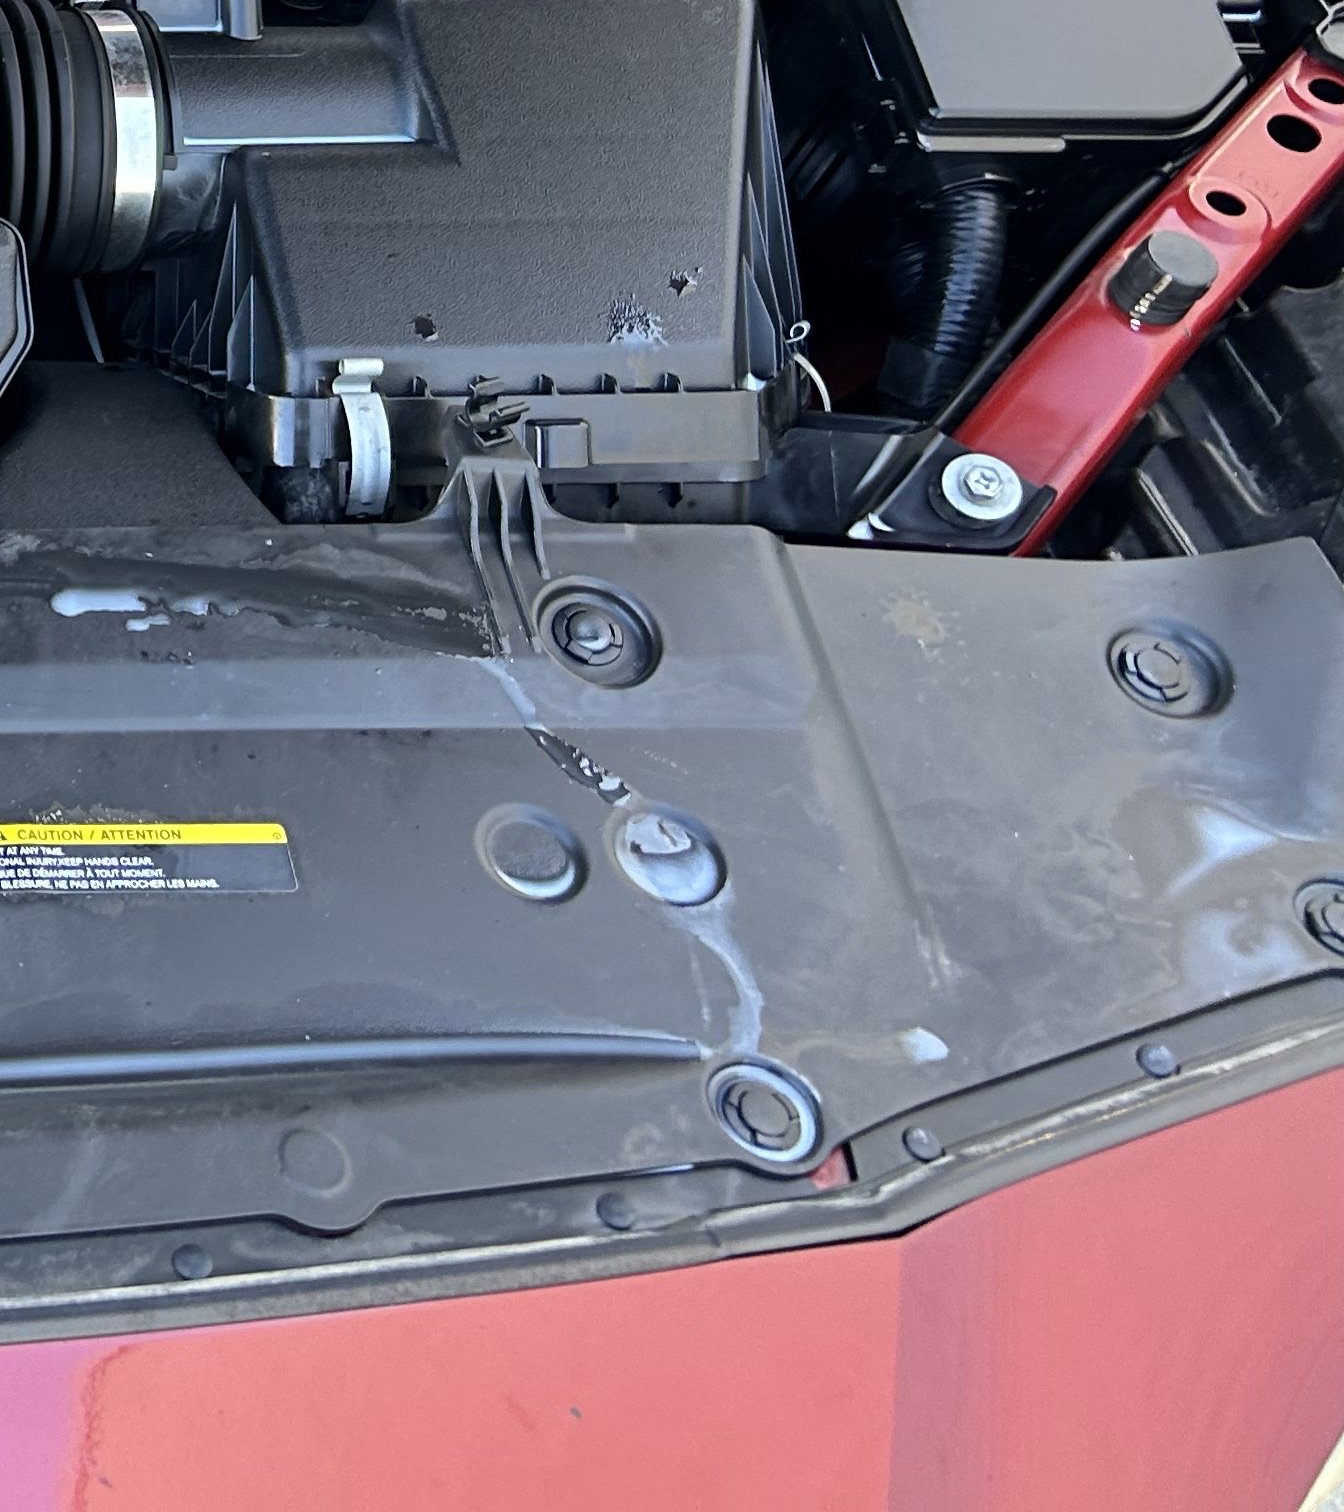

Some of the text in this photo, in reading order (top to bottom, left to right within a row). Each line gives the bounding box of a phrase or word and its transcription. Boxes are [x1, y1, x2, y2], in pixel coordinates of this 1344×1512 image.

[17, 829, 83, 841] CAUTION
[101, 829, 182, 840] ATTENTION
[6, 847, 17, 857] AT
[19, 847, 38, 857] ANY
[84, 857, 119, 867] HANDS
[17, 869, 31, 879] DE
[95, 869, 119, 879] TOUT
[54, 879, 68, 890] NE
[69, 879, 89, 890] PAS
[90, 879, 104, 890] EN
[166, 879, 185, 890] LES
